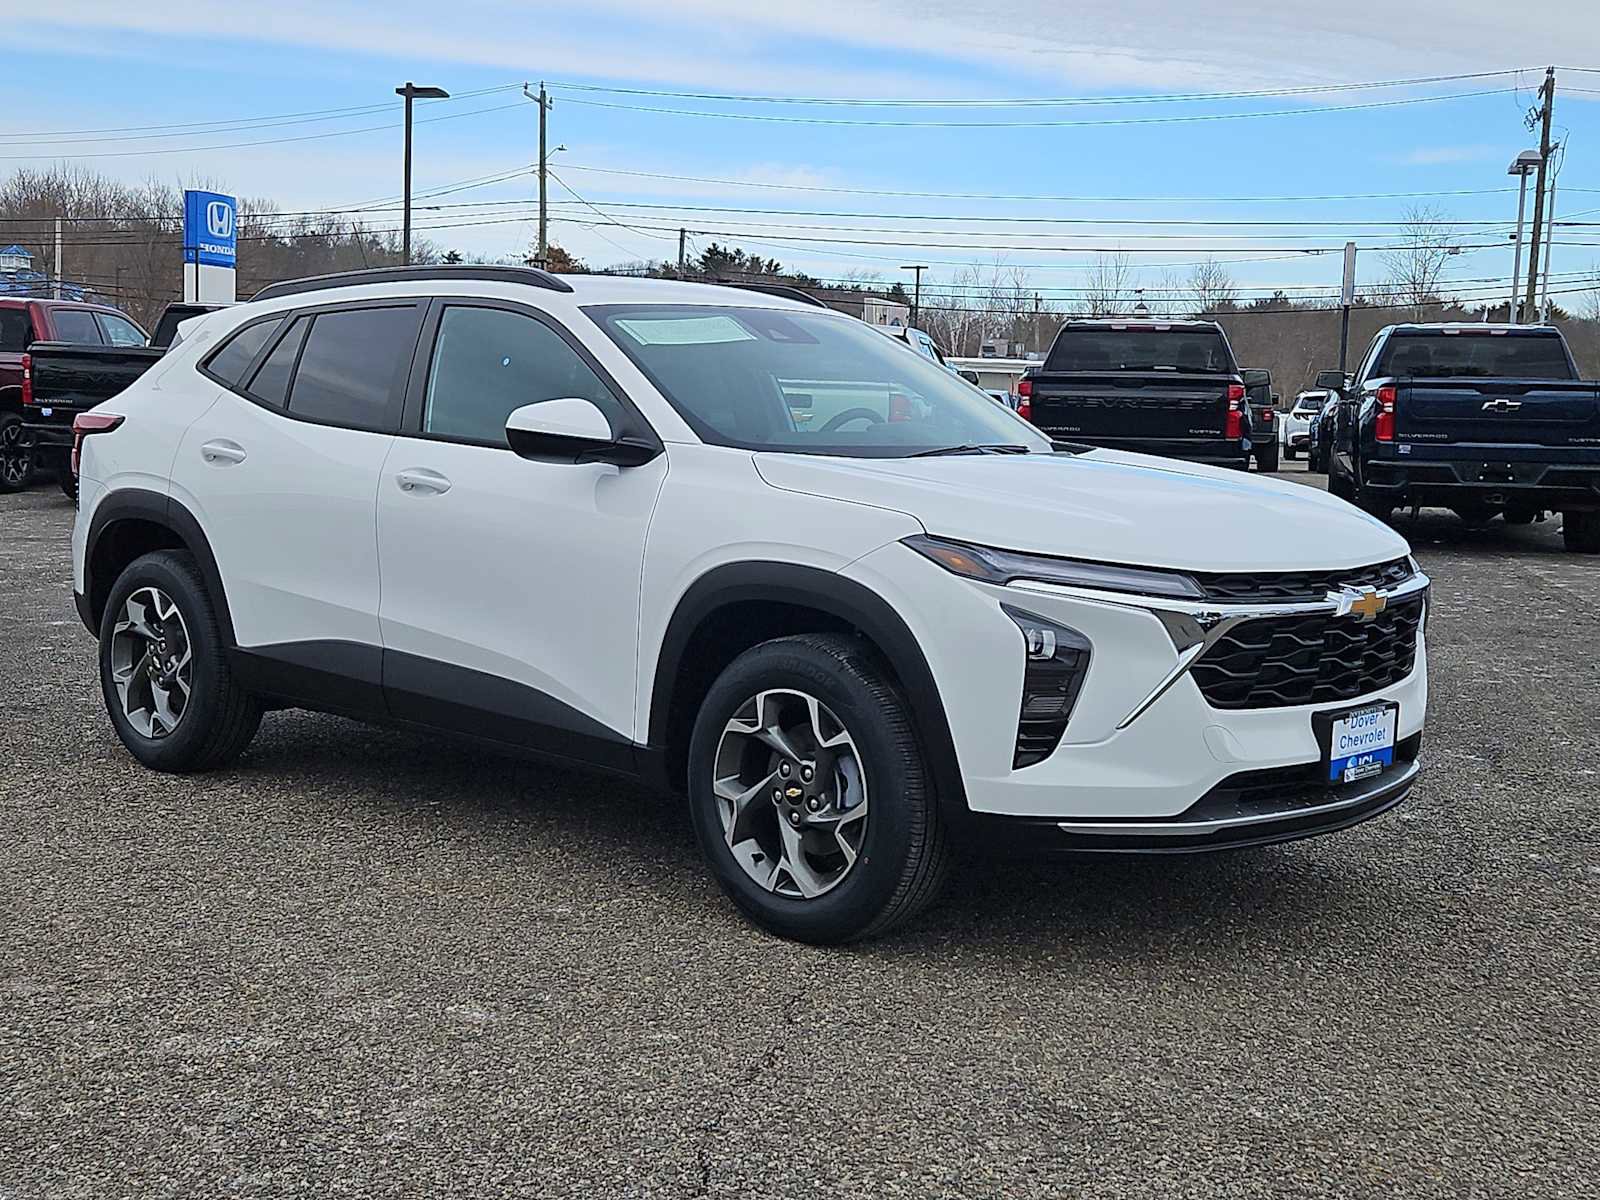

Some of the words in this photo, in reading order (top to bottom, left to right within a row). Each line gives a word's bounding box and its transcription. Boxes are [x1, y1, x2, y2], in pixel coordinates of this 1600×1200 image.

[199, 242, 237, 257] HONDA
[1350, 714, 1379, 729] Dover
[1340, 728, 1386, 749] Chevrolet
